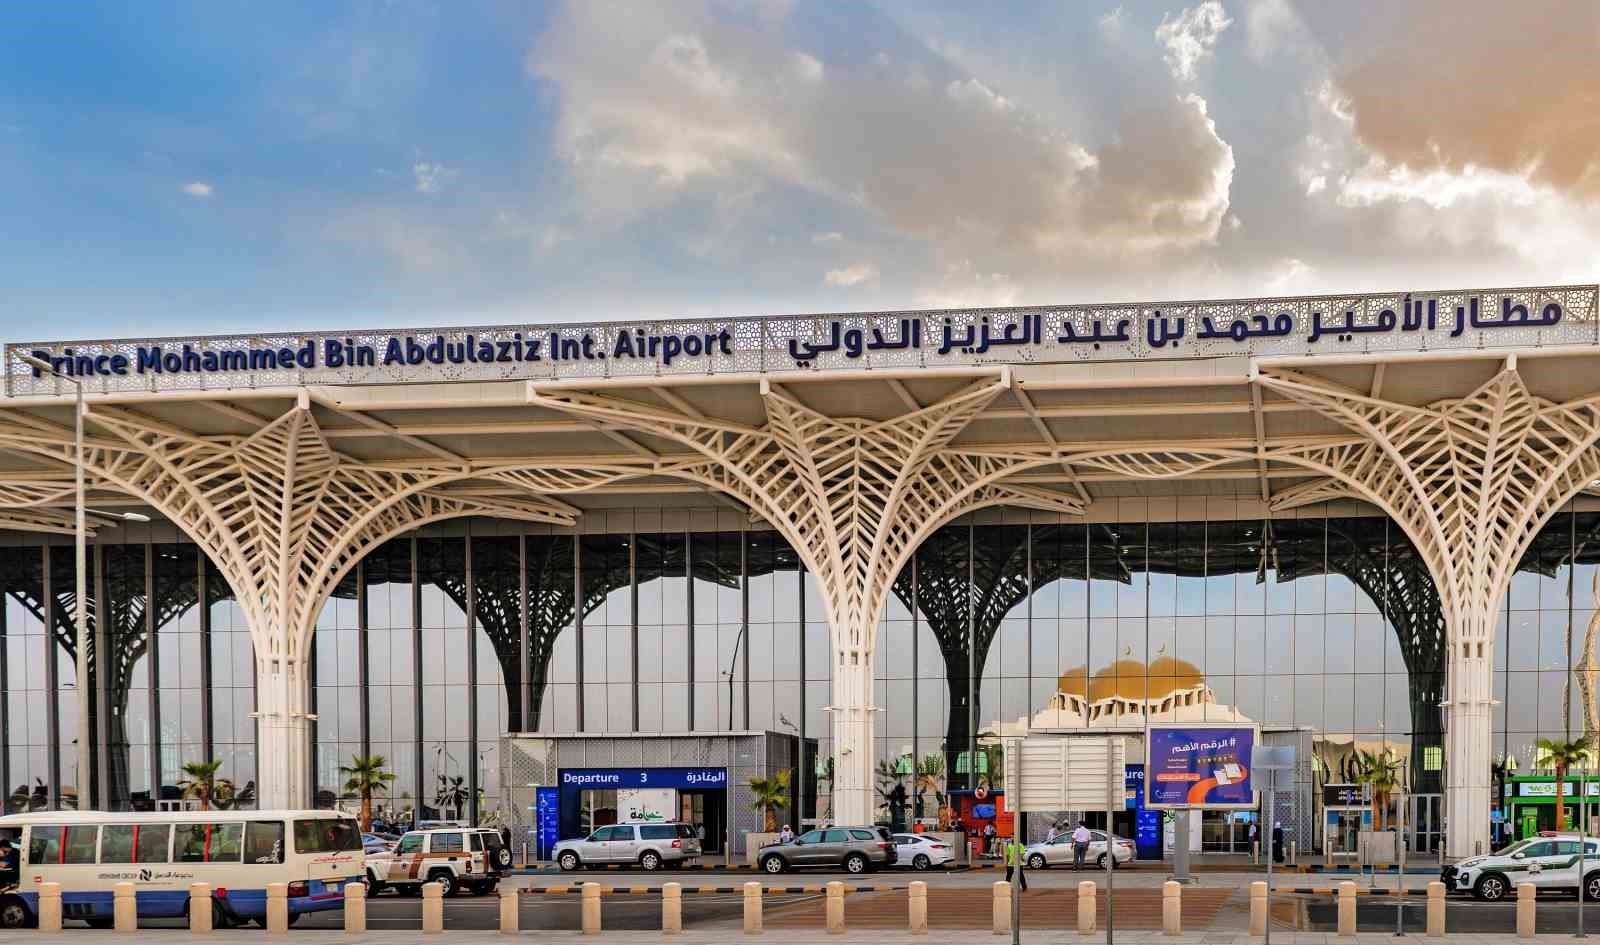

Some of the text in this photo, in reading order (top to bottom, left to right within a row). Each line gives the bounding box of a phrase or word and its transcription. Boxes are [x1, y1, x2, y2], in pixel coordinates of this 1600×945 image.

[788, 293, 1562, 367] مطار الأمير محمد بن عبد العزيز الدولي
[32, 328, 733, 378] Prince Mohammed Bin Abdulaziz Int. Airport
[563, 773, 648, 784] Departure 3
[686, 771, 725, 784] المغادرة
